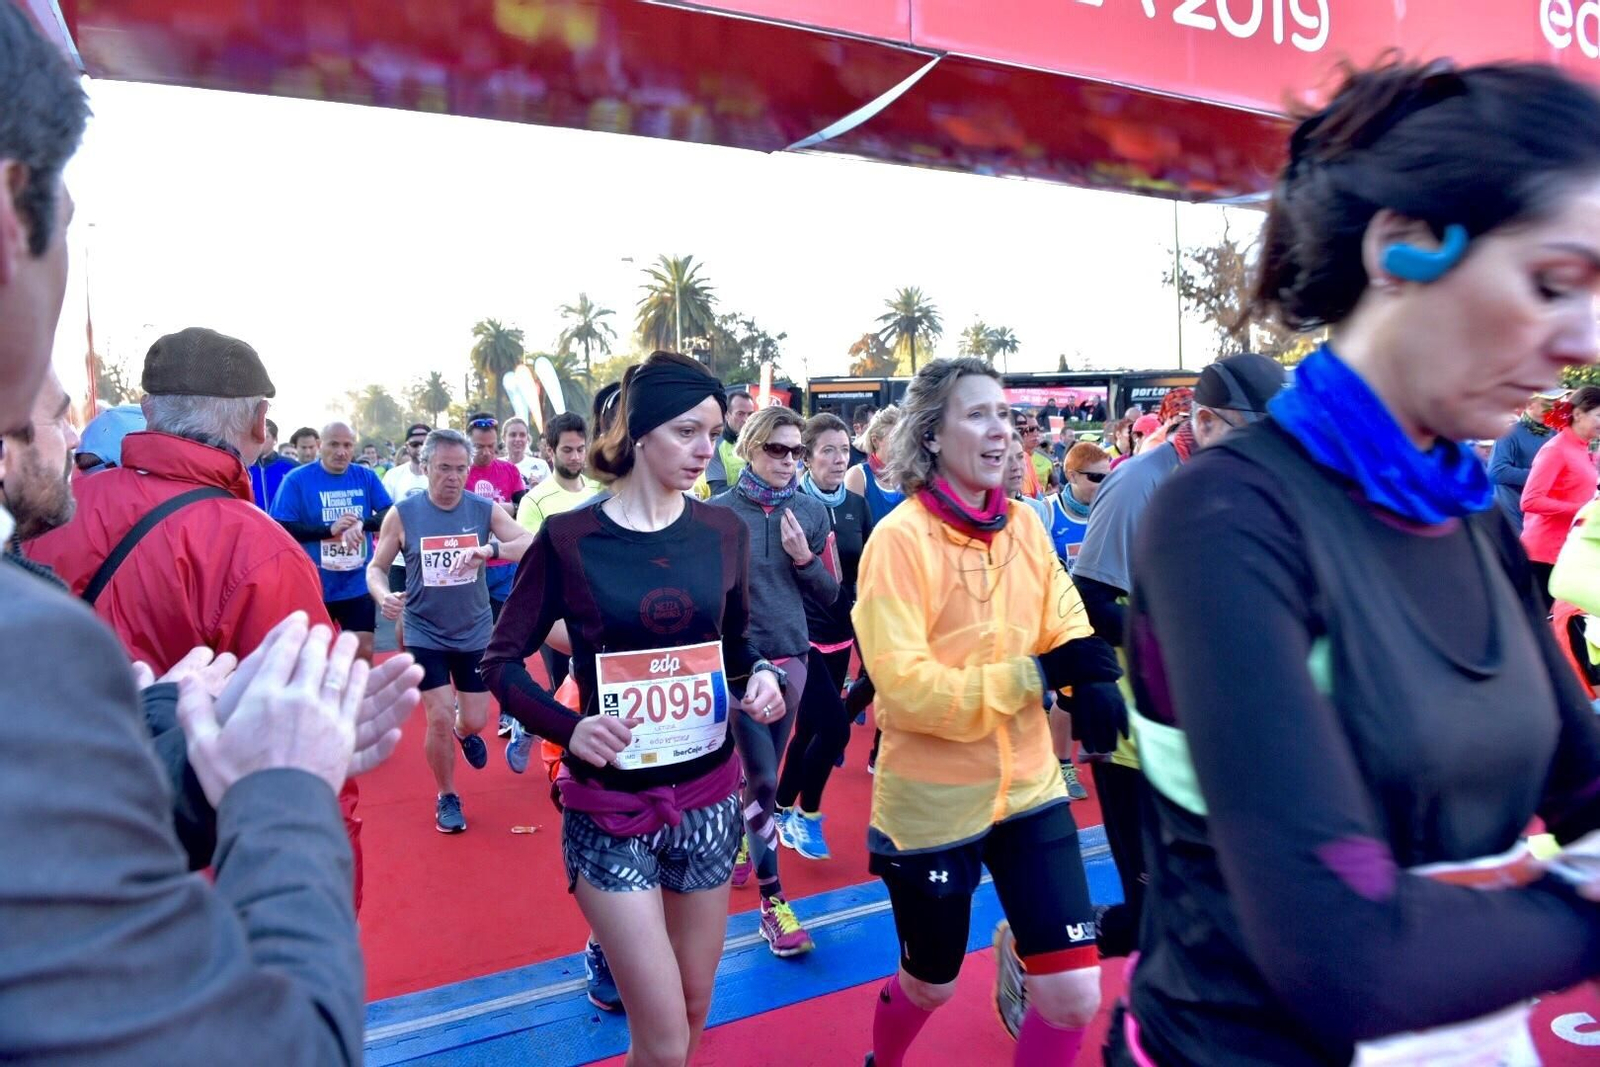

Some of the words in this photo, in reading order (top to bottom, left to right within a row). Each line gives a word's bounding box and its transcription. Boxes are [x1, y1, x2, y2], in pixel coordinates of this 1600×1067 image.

[444, 538, 459, 548] edp
[649, 654, 680, 677] edp
[621, 680, 712, 725] 2095
